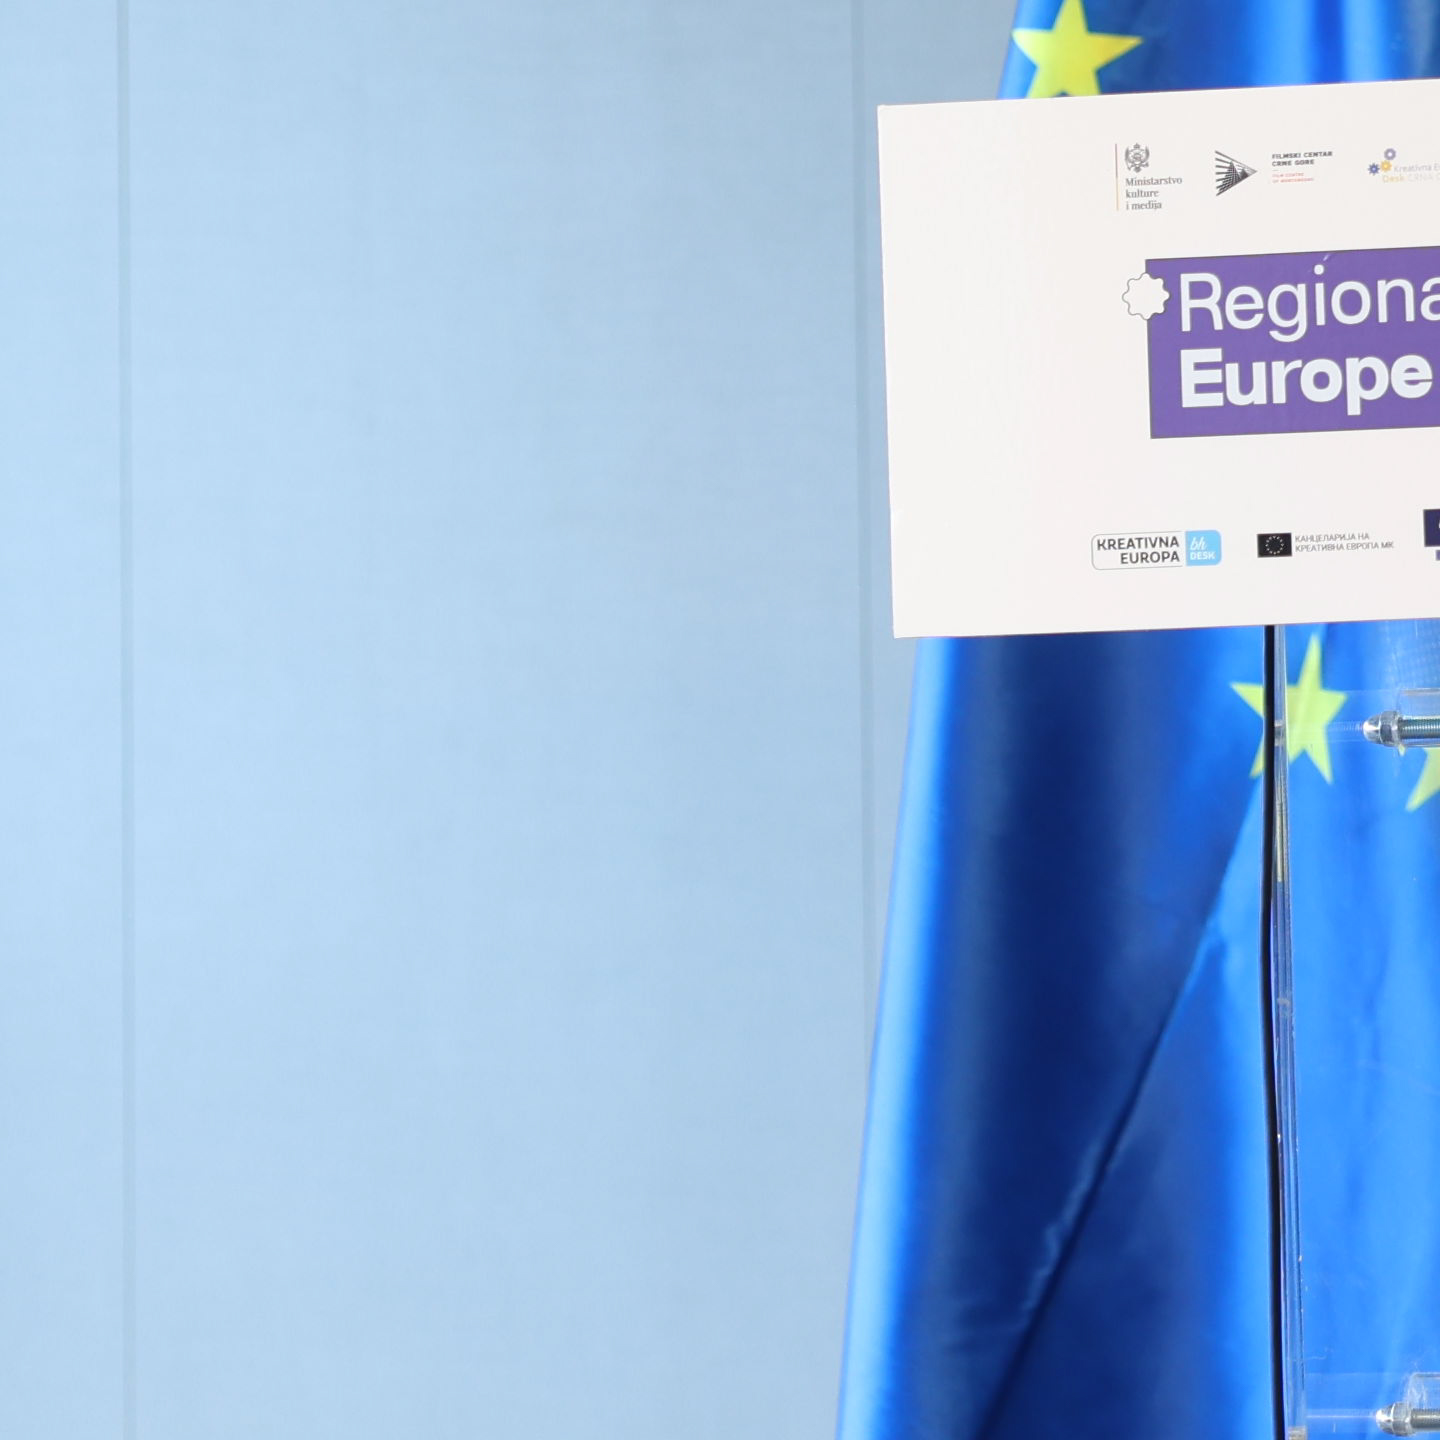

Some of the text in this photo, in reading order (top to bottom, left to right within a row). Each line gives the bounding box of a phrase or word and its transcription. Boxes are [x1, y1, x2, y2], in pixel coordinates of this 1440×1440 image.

[1272, 152, 1301, 160] FILMSKI
[1125, 176, 1182, 187] Ministarstvo
[1125, 188, 1159, 198] kulture
[1131, 200, 1162, 210] medija
[1180, 347, 1433, 416] Europe
[1097, 536, 1180, 551] KREATIVNA
[1190, 537, 1207, 552] bh
[1346, 542, 1379, 551] ЕВРОПА
[1120, 552, 1180, 565] EUROPA
[1190, 552, 1215, 561] DESK
